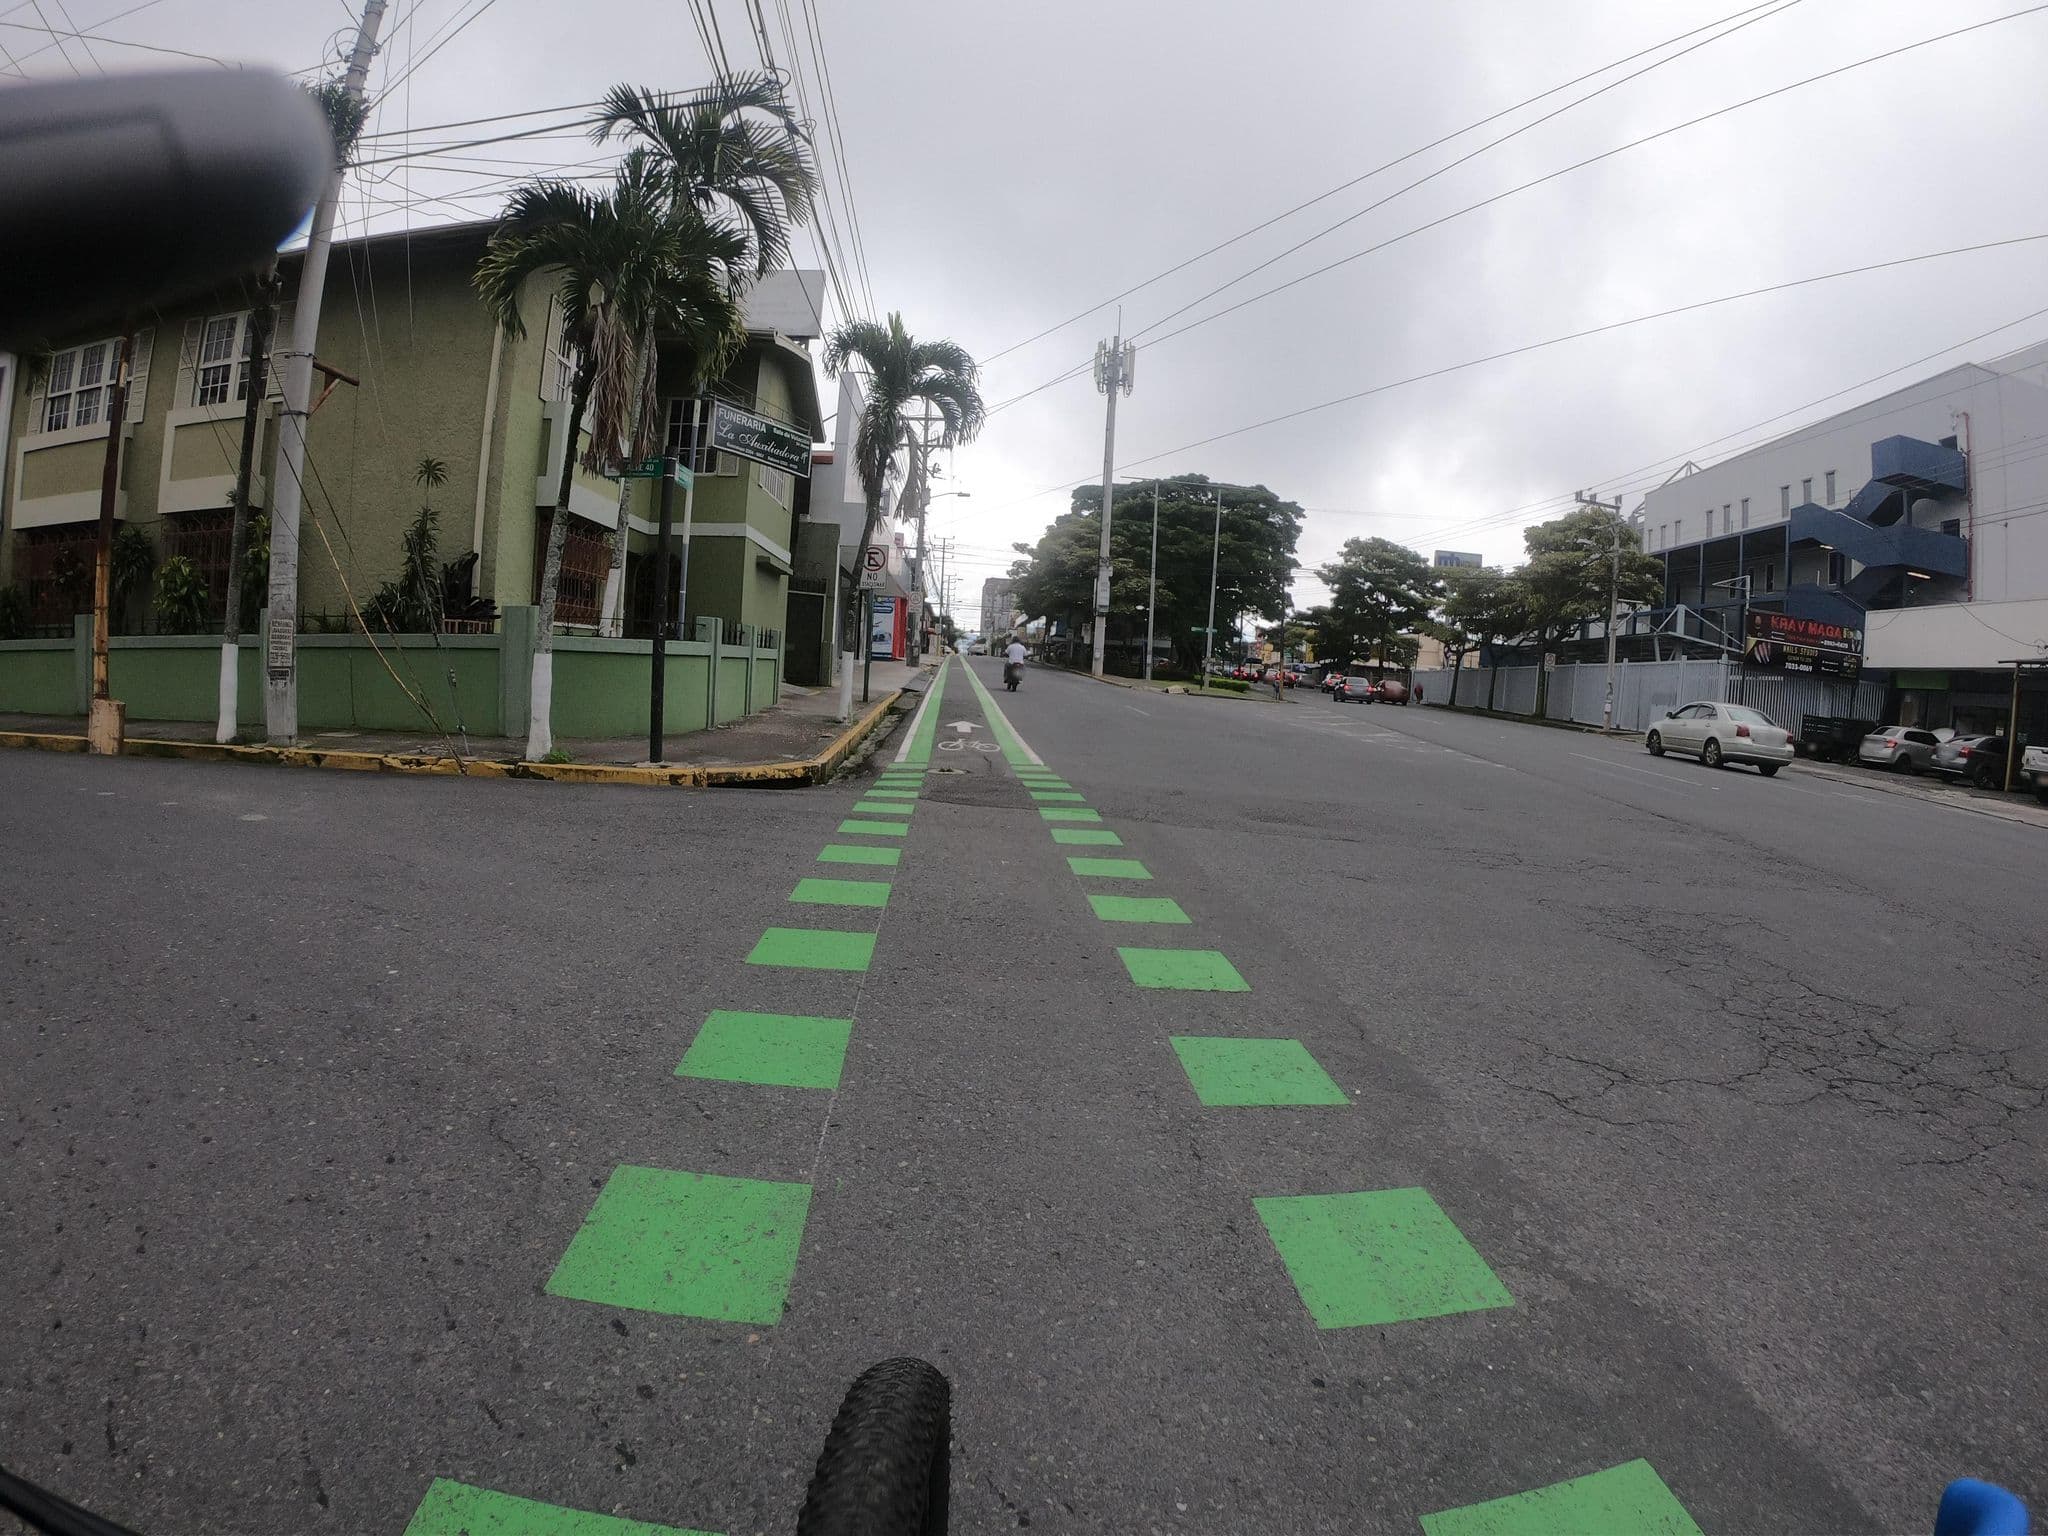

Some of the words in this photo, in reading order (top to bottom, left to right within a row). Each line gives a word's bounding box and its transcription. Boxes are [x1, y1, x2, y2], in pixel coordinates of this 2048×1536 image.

[718, 407, 767, 434] FUNERARIA
[717, 421, 735, 440] La
[739, 433, 799, 461] Auxiliadora
[645, 463, 654, 472] 40
[1771, 616, 1805, 632] KRAV
[1808, 623, 1842, 639] MAGA
[1799, 648, 1818, 657] STUDIO
